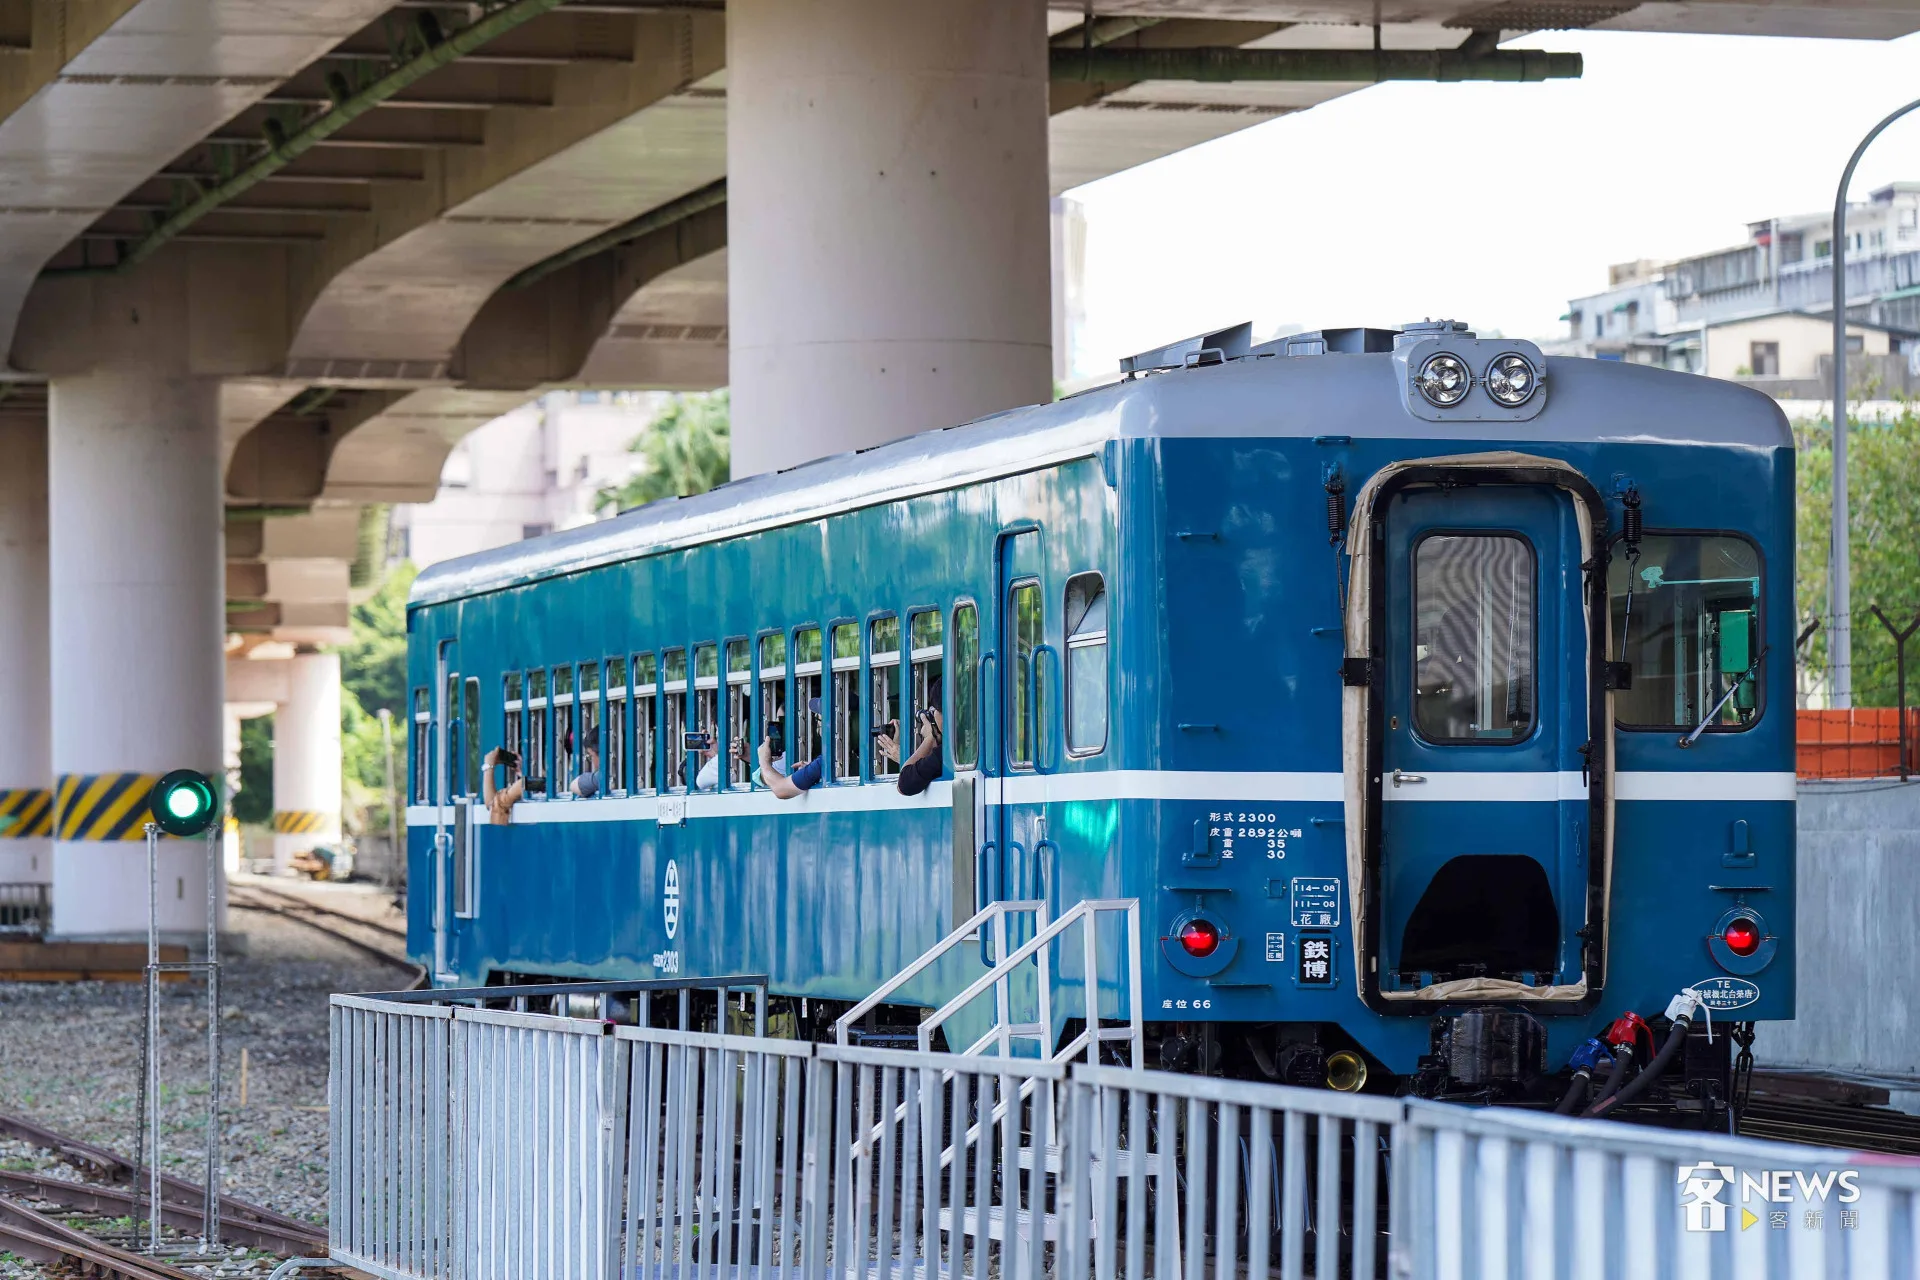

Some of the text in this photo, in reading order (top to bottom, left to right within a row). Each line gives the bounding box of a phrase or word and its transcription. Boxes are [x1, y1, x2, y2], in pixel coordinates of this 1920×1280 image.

[1209, 812, 1276, 823] 形式 2300
[1209, 827, 1234, 837] 皮重
[1222, 838, 1286, 849] 重 35
[1222, 849, 1286, 859] 空 30
[1717, 980, 1731, 989] TE
[1162, 999, 1211, 1009] 座位 66
